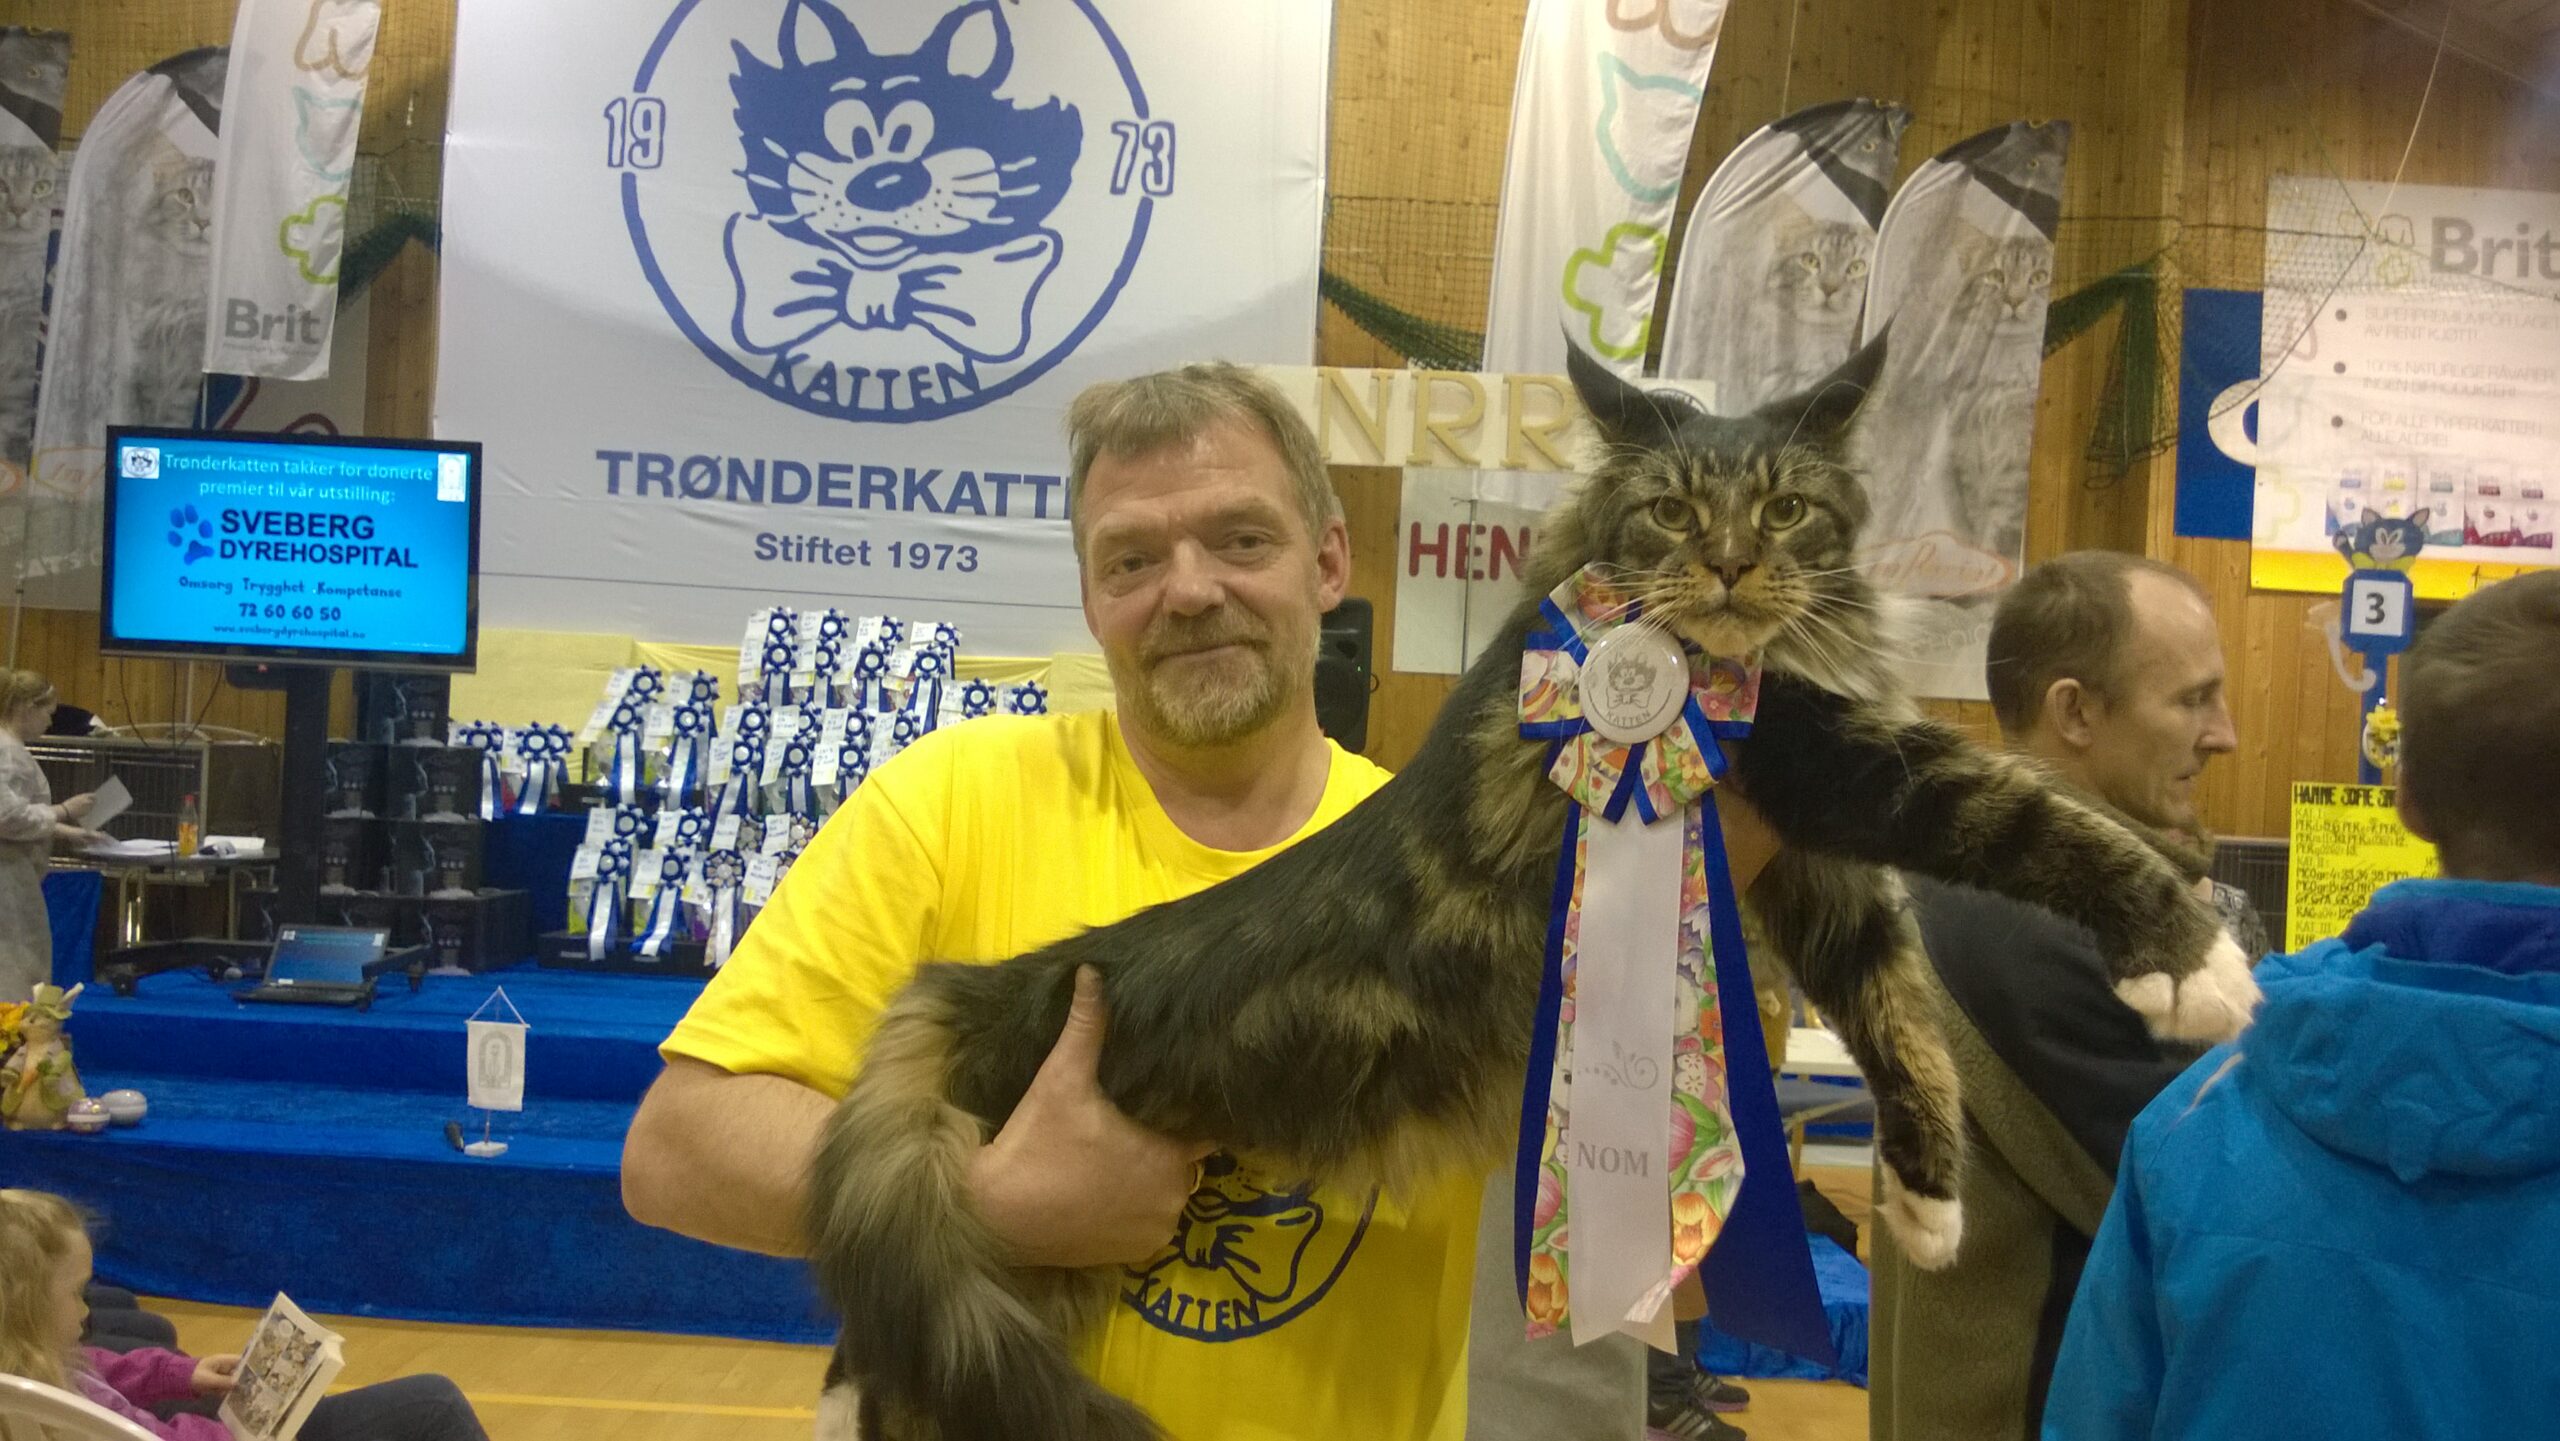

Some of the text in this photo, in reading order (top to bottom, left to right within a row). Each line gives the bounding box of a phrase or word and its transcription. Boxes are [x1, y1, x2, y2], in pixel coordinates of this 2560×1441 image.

[604, 96, 665, 170] 19
[1110, 120, 1176, 197] 73
[2431, 217, 2560, 280] Brit
[225, 298, 321, 344] Brit
[766, 352, 981, 412] KATTEN
[164, 454, 433, 481] Trønderkatten takker for donerte
[595, 450, 1072, 520] TRØNDERKATT
[199, 480, 396, 505] premier til vår utstilling:
[220, 509, 375, 539] SVEBERG
[220, 539, 418, 569] DYREHOSPITAL
[754, 533, 979, 573] Stiftet 1973
[1409, 521, 1541, 581] HEN
[179, 576, 402, 601] Omsorg Trygghet Kompetanse
[239, 602, 341, 621] 72 60 60 50
[2363, 592, 2386, 624] 3
[1605, 709, 1651, 727] KATTEN
[1576, 1142, 1650, 1178] NOM
[1137, 1275, 1261, 1334] KATTEN
